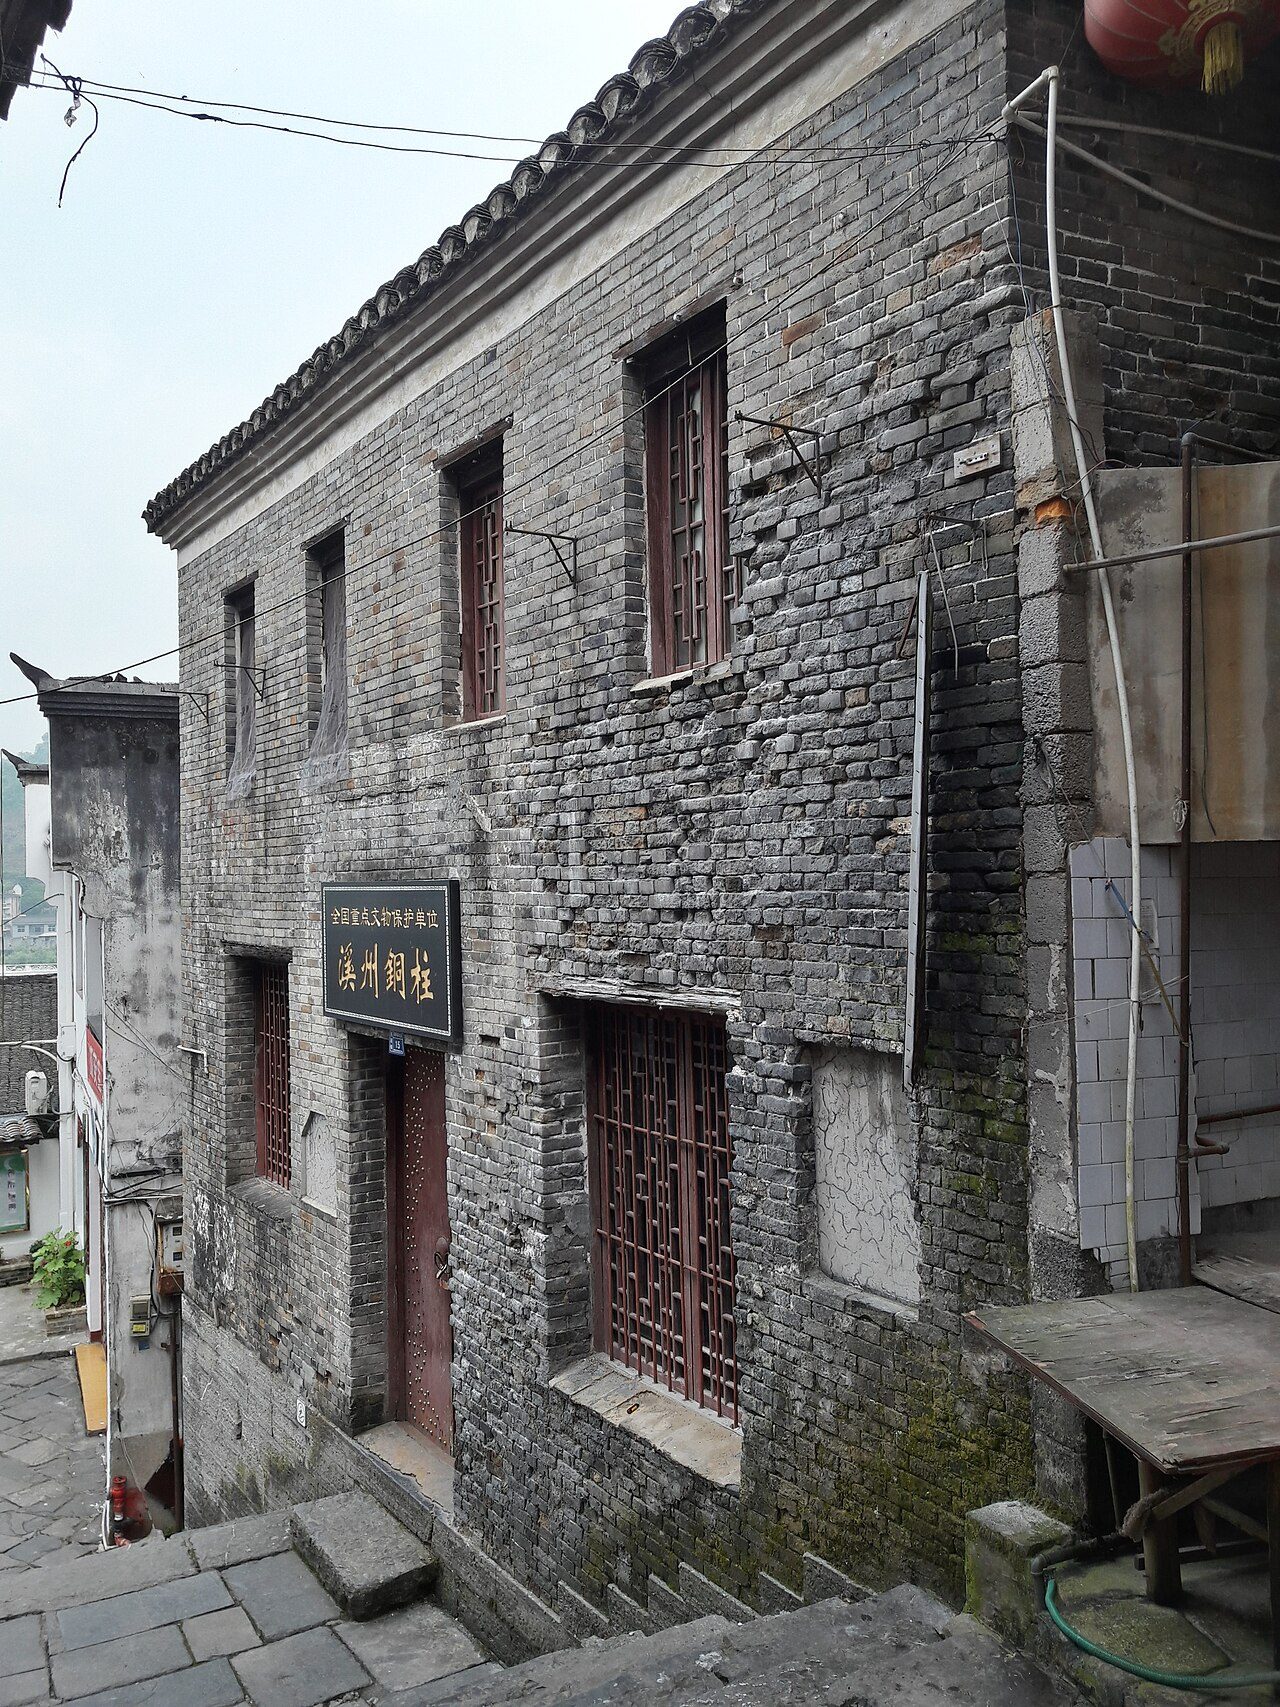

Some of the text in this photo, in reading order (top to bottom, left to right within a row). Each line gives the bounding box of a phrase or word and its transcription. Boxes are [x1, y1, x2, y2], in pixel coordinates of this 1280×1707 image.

[331, 906, 438, 929] 全国重点文物保护单位
[338, 942, 434, 1004] 溪州銅柱
[394, 1040, 401, 1050] 15
